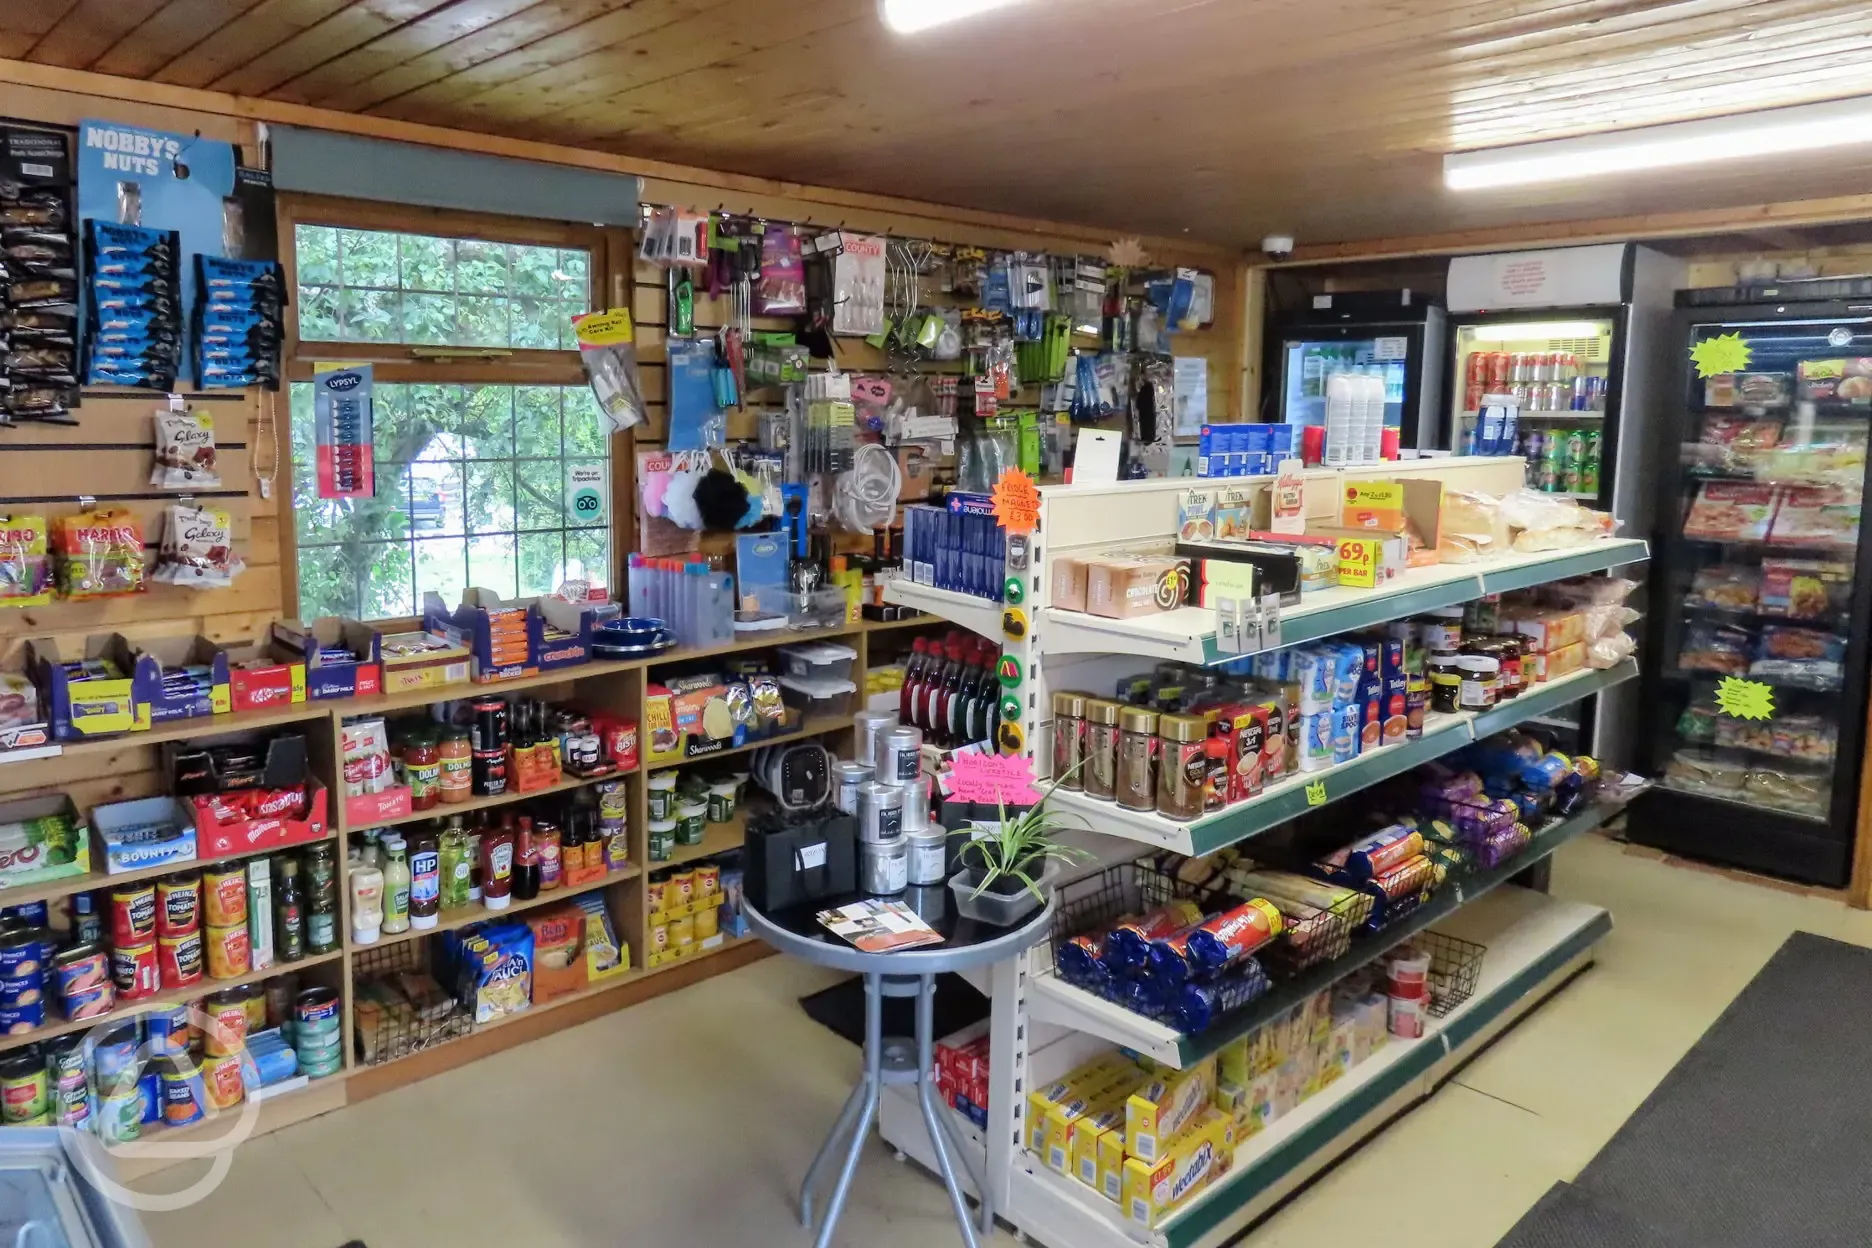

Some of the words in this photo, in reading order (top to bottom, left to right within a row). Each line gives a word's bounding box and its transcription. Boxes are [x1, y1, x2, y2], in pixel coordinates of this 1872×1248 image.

[86, 127, 181, 160] NOBBY'S
[103, 152, 160, 177] NUTS
[845, 243, 880, 256] COUNTY
[329, 376, 359, 388] LYPSYL
[1339, 541, 1370, 566] 69p
[1353, 568, 1368, 577] BAR
[1126, 583, 1159, 599] CHOCOLATE
[1389, 679, 1407, 690] Tetley
[0, 846, 41, 870] ero
[120, 847, 175, 864] BOUNTY
[414, 859, 437, 874] HP
[171, 887, 199, 902] HEINZ
[167, 900, 197, 913] TOMATO
[1171, 1140, 1213, 1201] Weetabix
